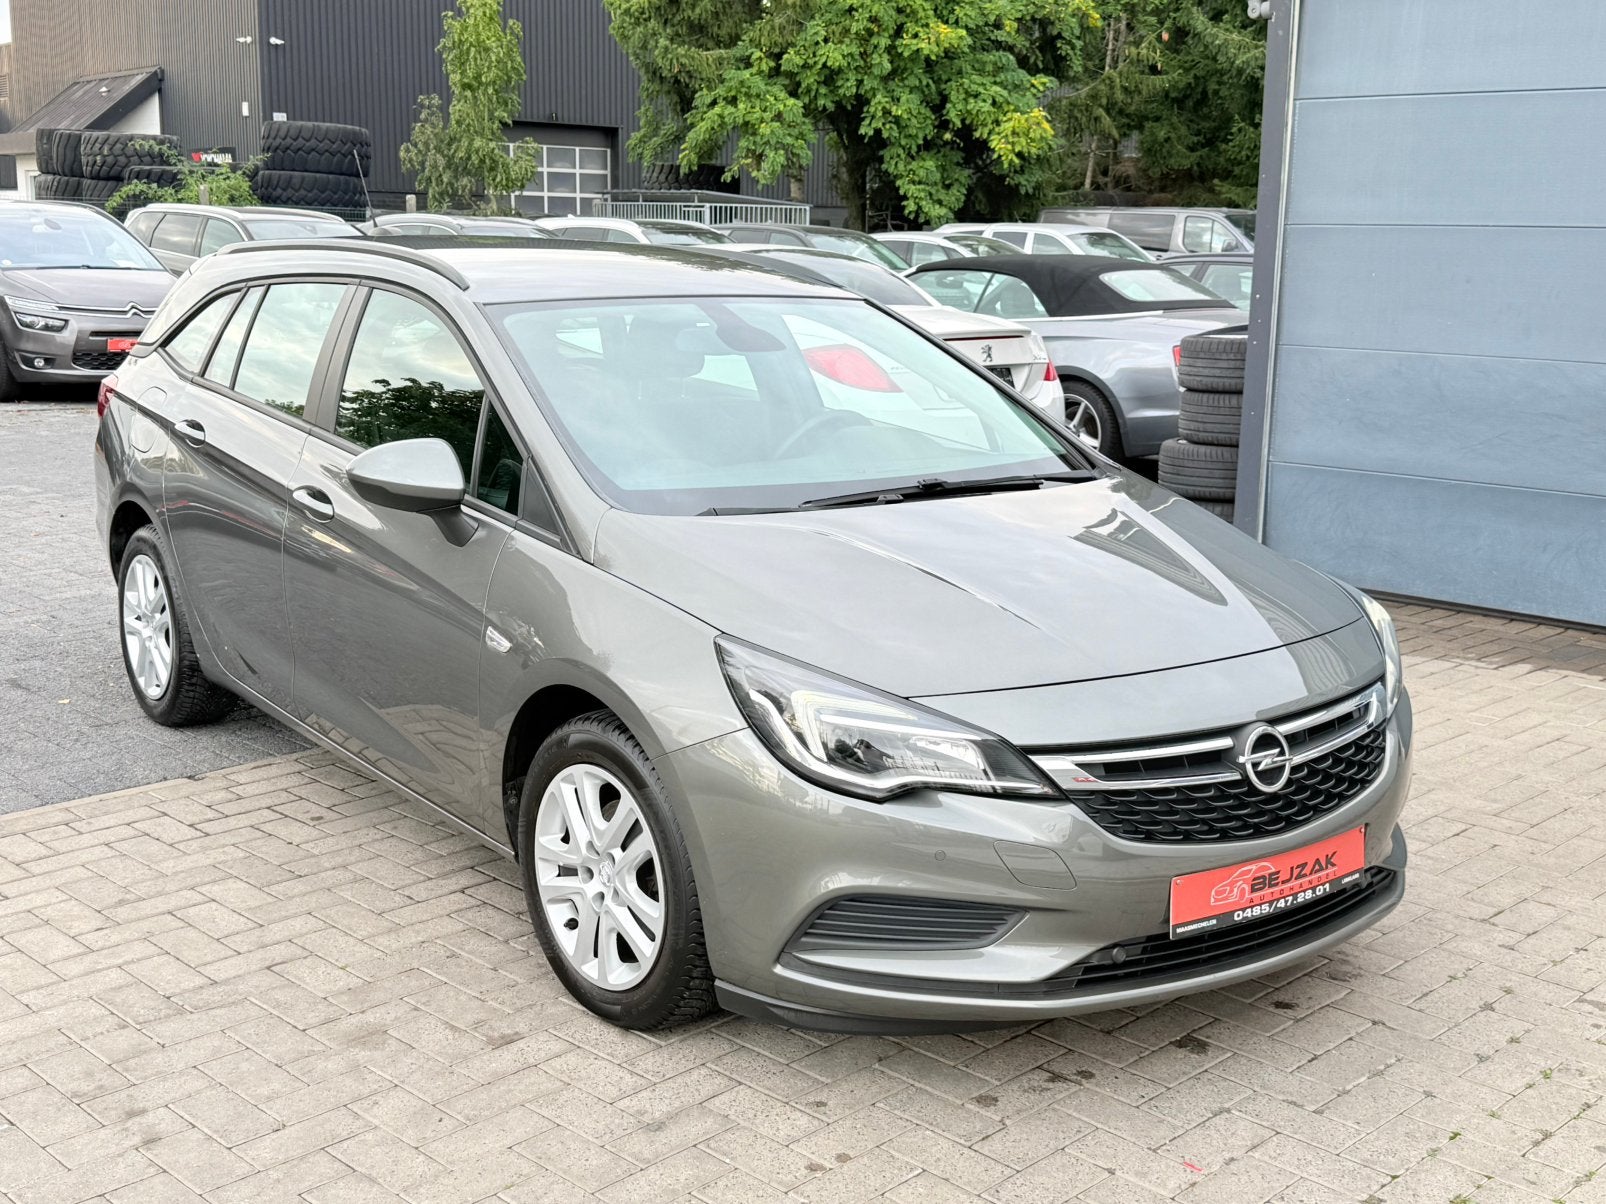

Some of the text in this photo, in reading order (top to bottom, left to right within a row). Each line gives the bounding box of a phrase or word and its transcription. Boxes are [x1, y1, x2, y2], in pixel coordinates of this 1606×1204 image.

[1249, 870, 1337, 904] AUTOHANDEL
[1251, 851, 1337, 893] BEJZAK
[1233, 883, 1330, 921] 0485/47.28.01
[1176, 919, 1217, 933] MAASMECHELEN
